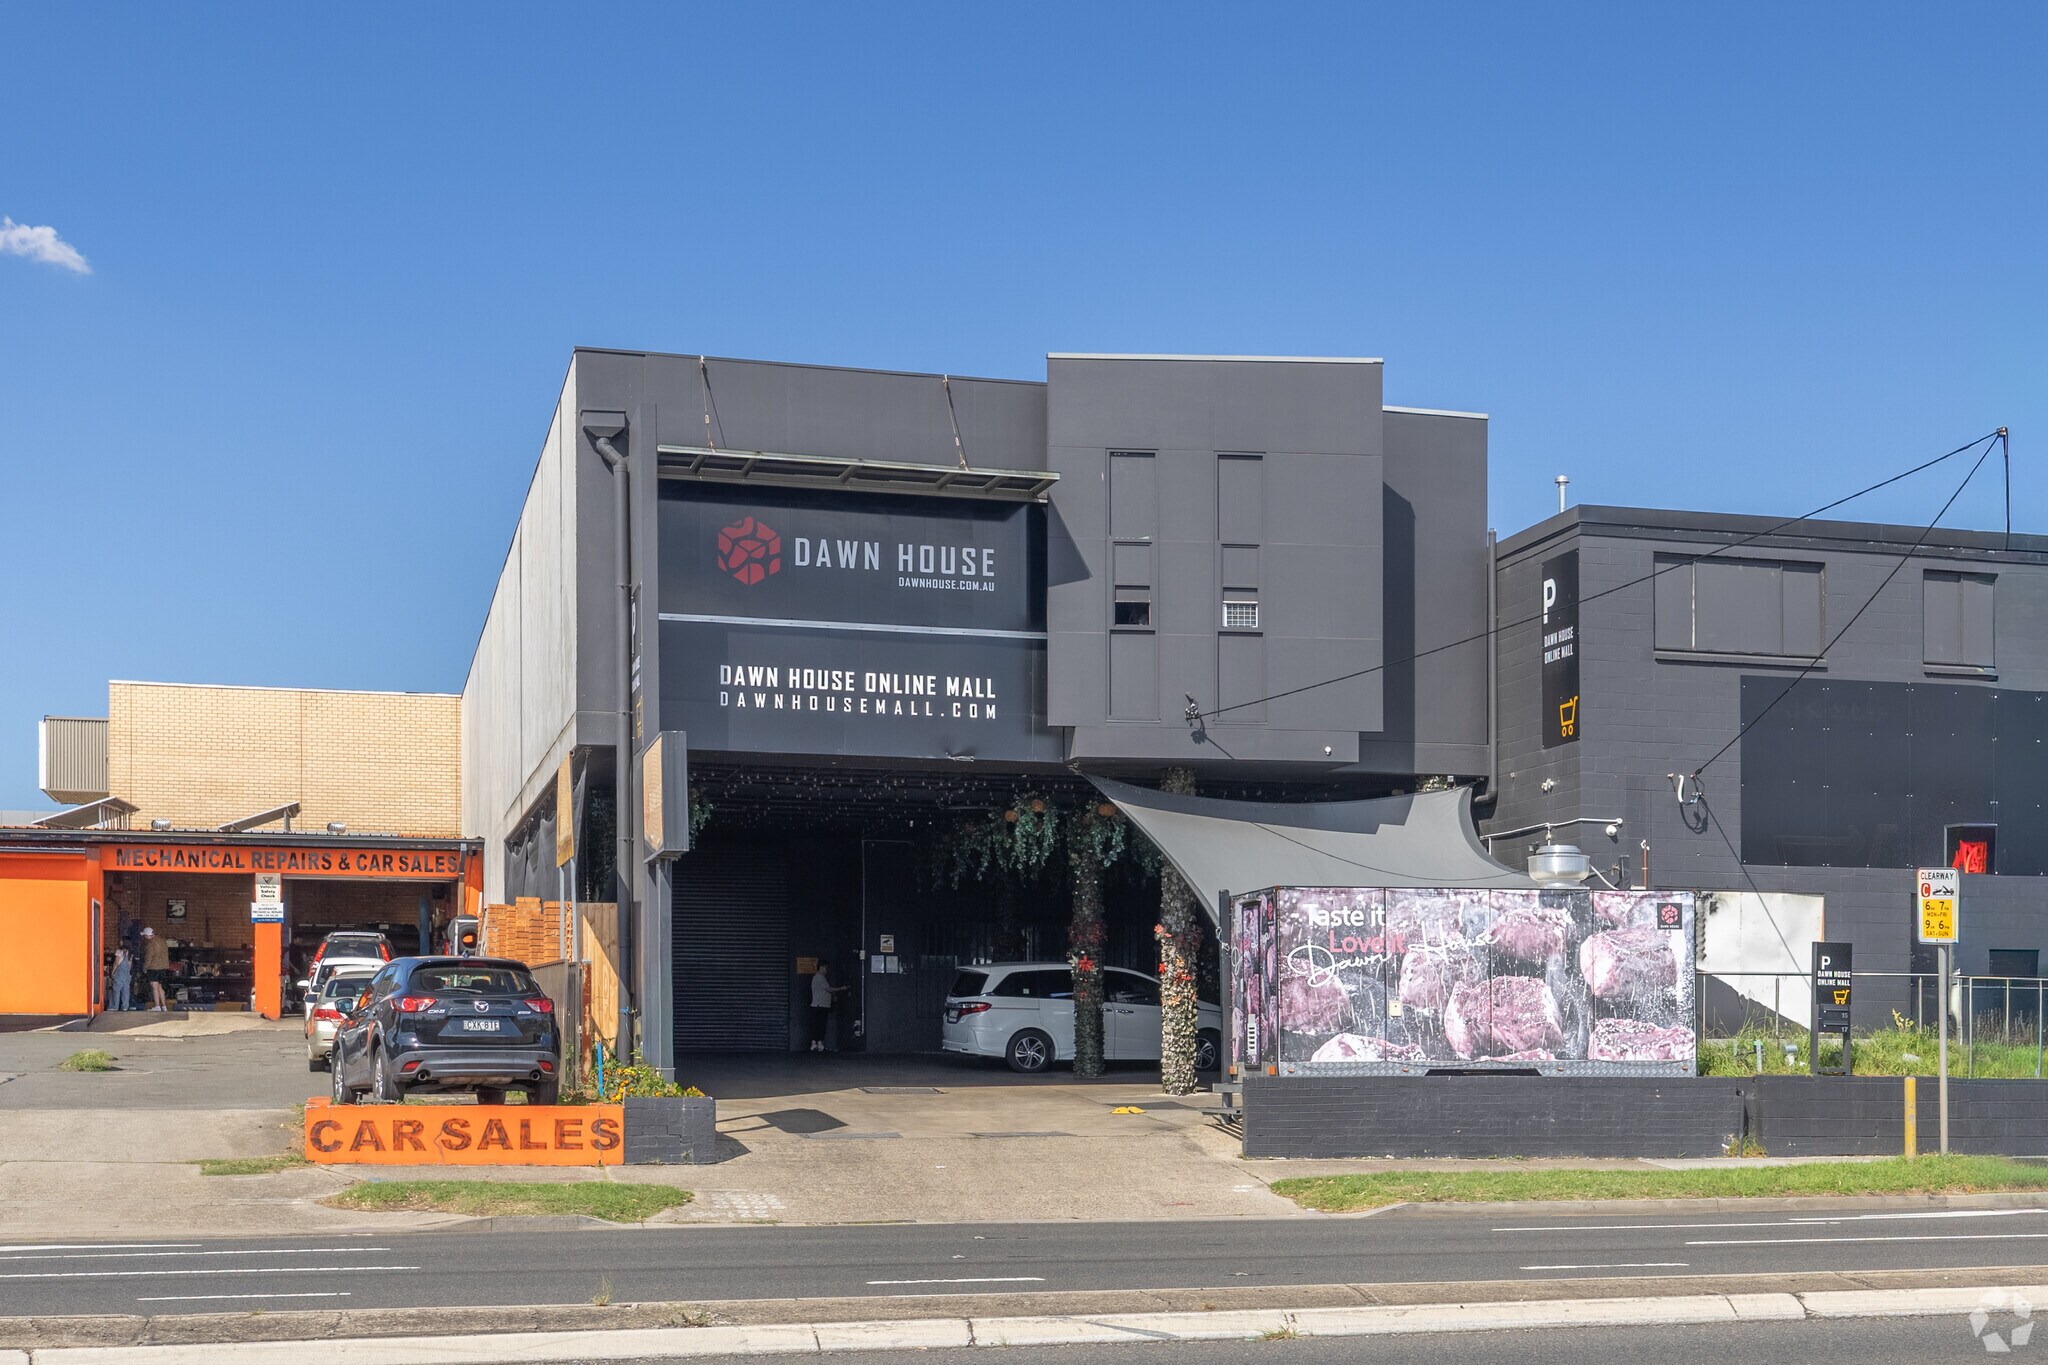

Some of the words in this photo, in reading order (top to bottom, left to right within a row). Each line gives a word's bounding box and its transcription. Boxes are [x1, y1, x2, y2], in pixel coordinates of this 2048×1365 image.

[795, 537, 880, 571] DAWN
[898, 543, 995, 577] HOUSE
[898, 576, 995, 592] DAWNHOUSE.COM.AU
[1543, 578, 1557, 625] P
[1544, 631, 1558, 648] DAWN
[1558, 626, 1574, 643] HOUSE
[1544, 647, 1561, 665] ONLINE
[1561, 643, 1574, 659] MALL
[720, 664, 779, 688] DAWN
[788, 668, 855, 692] HOUSE
[865, 672, 937, 696] ONLINE
[946, 676, 996, 699] MALL
[720, 691, 996, 720] DAWNHOUSEMALL.COM
[116, 848, 245, 869] MECHANICAL
[251, 850, 333, 871] REPAIRS
[338, 852, 351, 871] &
[356, 853, 394, 872] CAR
[398, 855, 459, 873] SALES
[1920, 871, 1954, 881] CLEARWAY
[1922, 884, 1929, 897] C
[1303, 903, 1365, 927] Taste
[1287, 939, 1392, 988] Dawn
[1407, 919, 1501, 966] House
[1329, 930, 1385, 954] Love
[1817, 970, 1833, 978] DAWN
[1821, 955, 1831, 970] P
[309, 1119, 427, 1152] CAR
[440, 1118, 621, 1151] SALES
